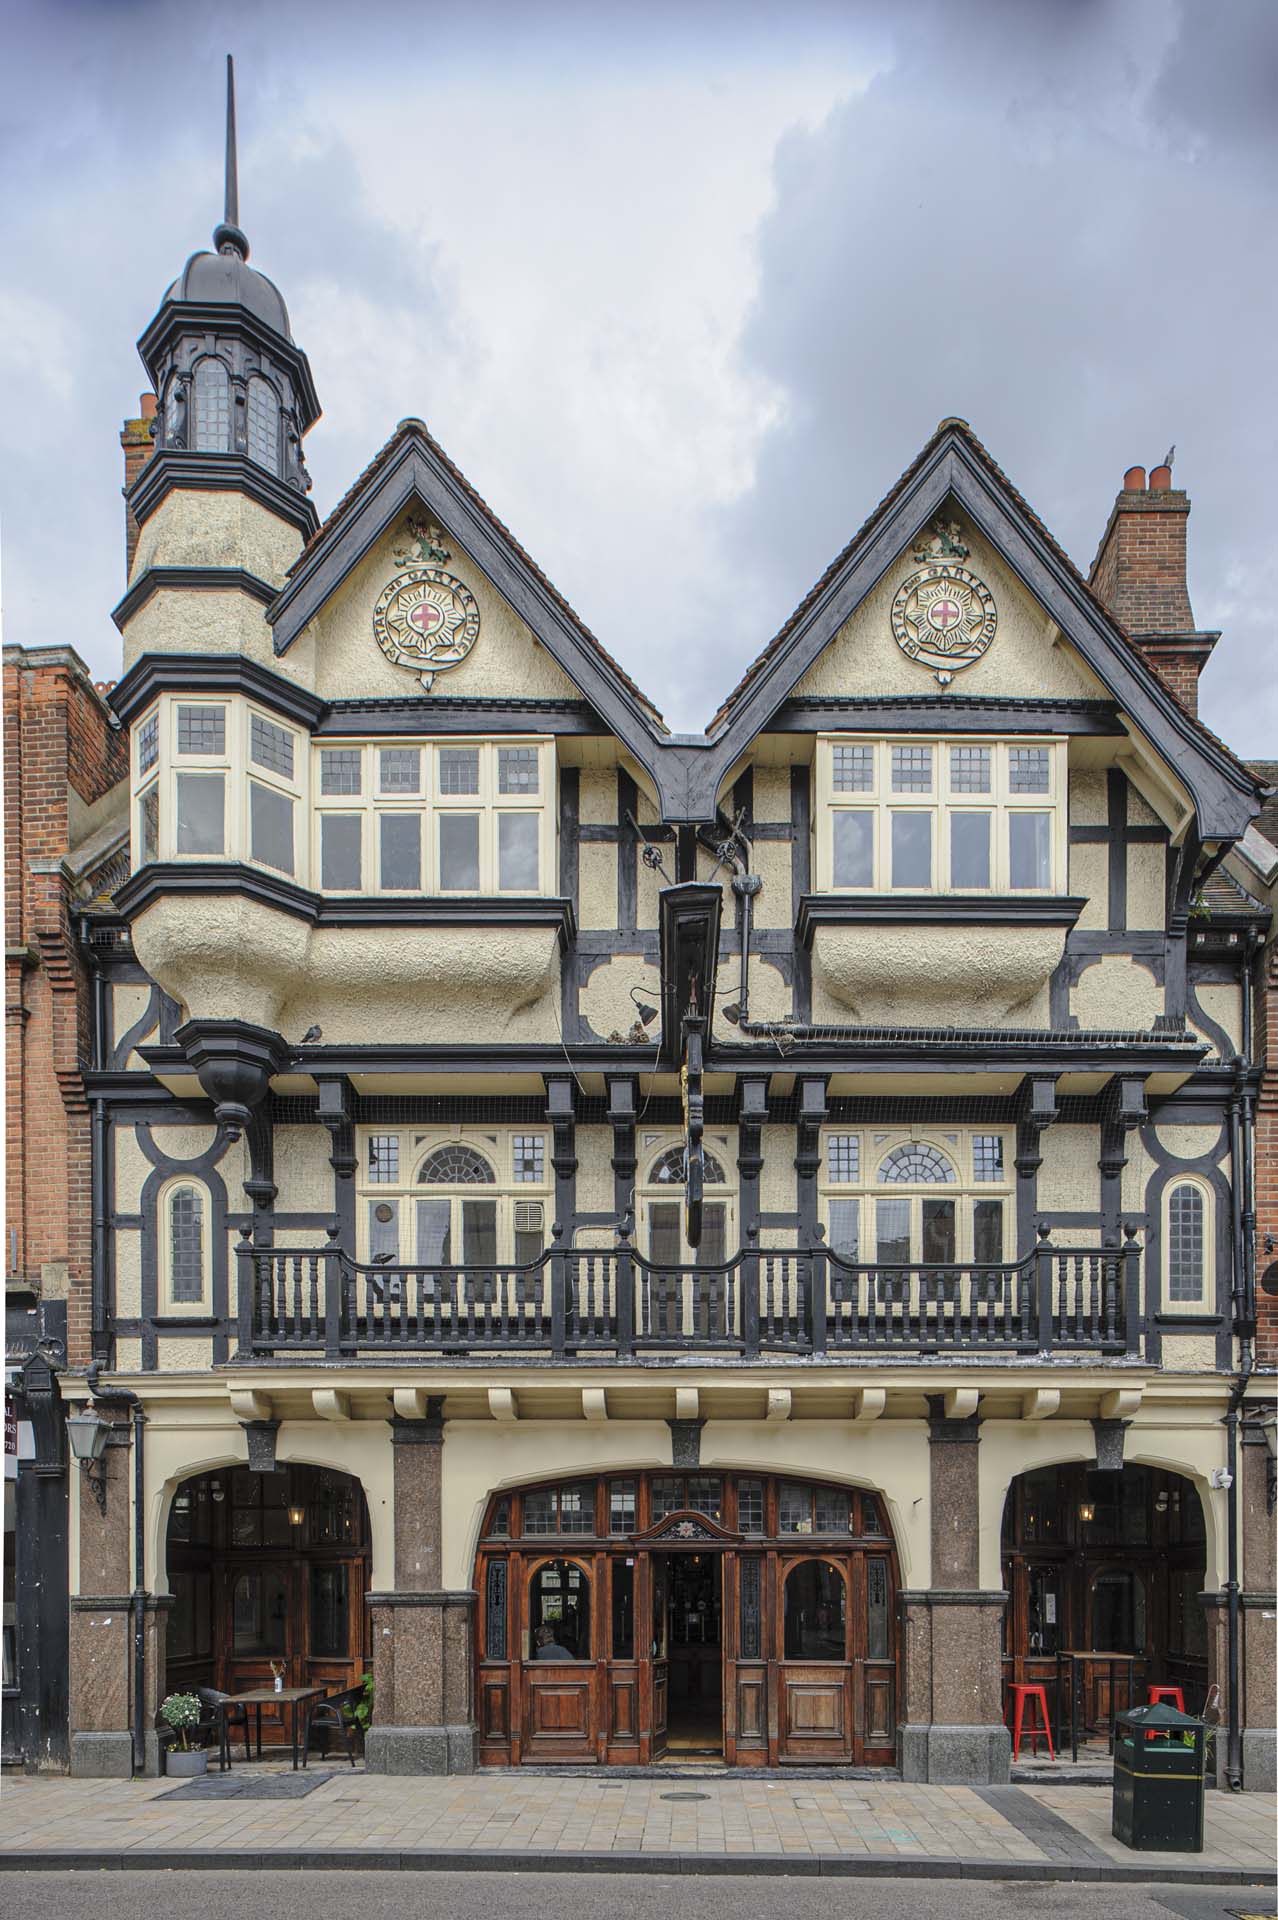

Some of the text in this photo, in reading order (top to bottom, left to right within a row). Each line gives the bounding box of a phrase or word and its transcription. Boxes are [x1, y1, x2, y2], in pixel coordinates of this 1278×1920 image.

[375, 569, 480, 656] STAR AND GARTER HOTEL
[893, 566, 996, 655] STAR AND GARTER HOTEL
